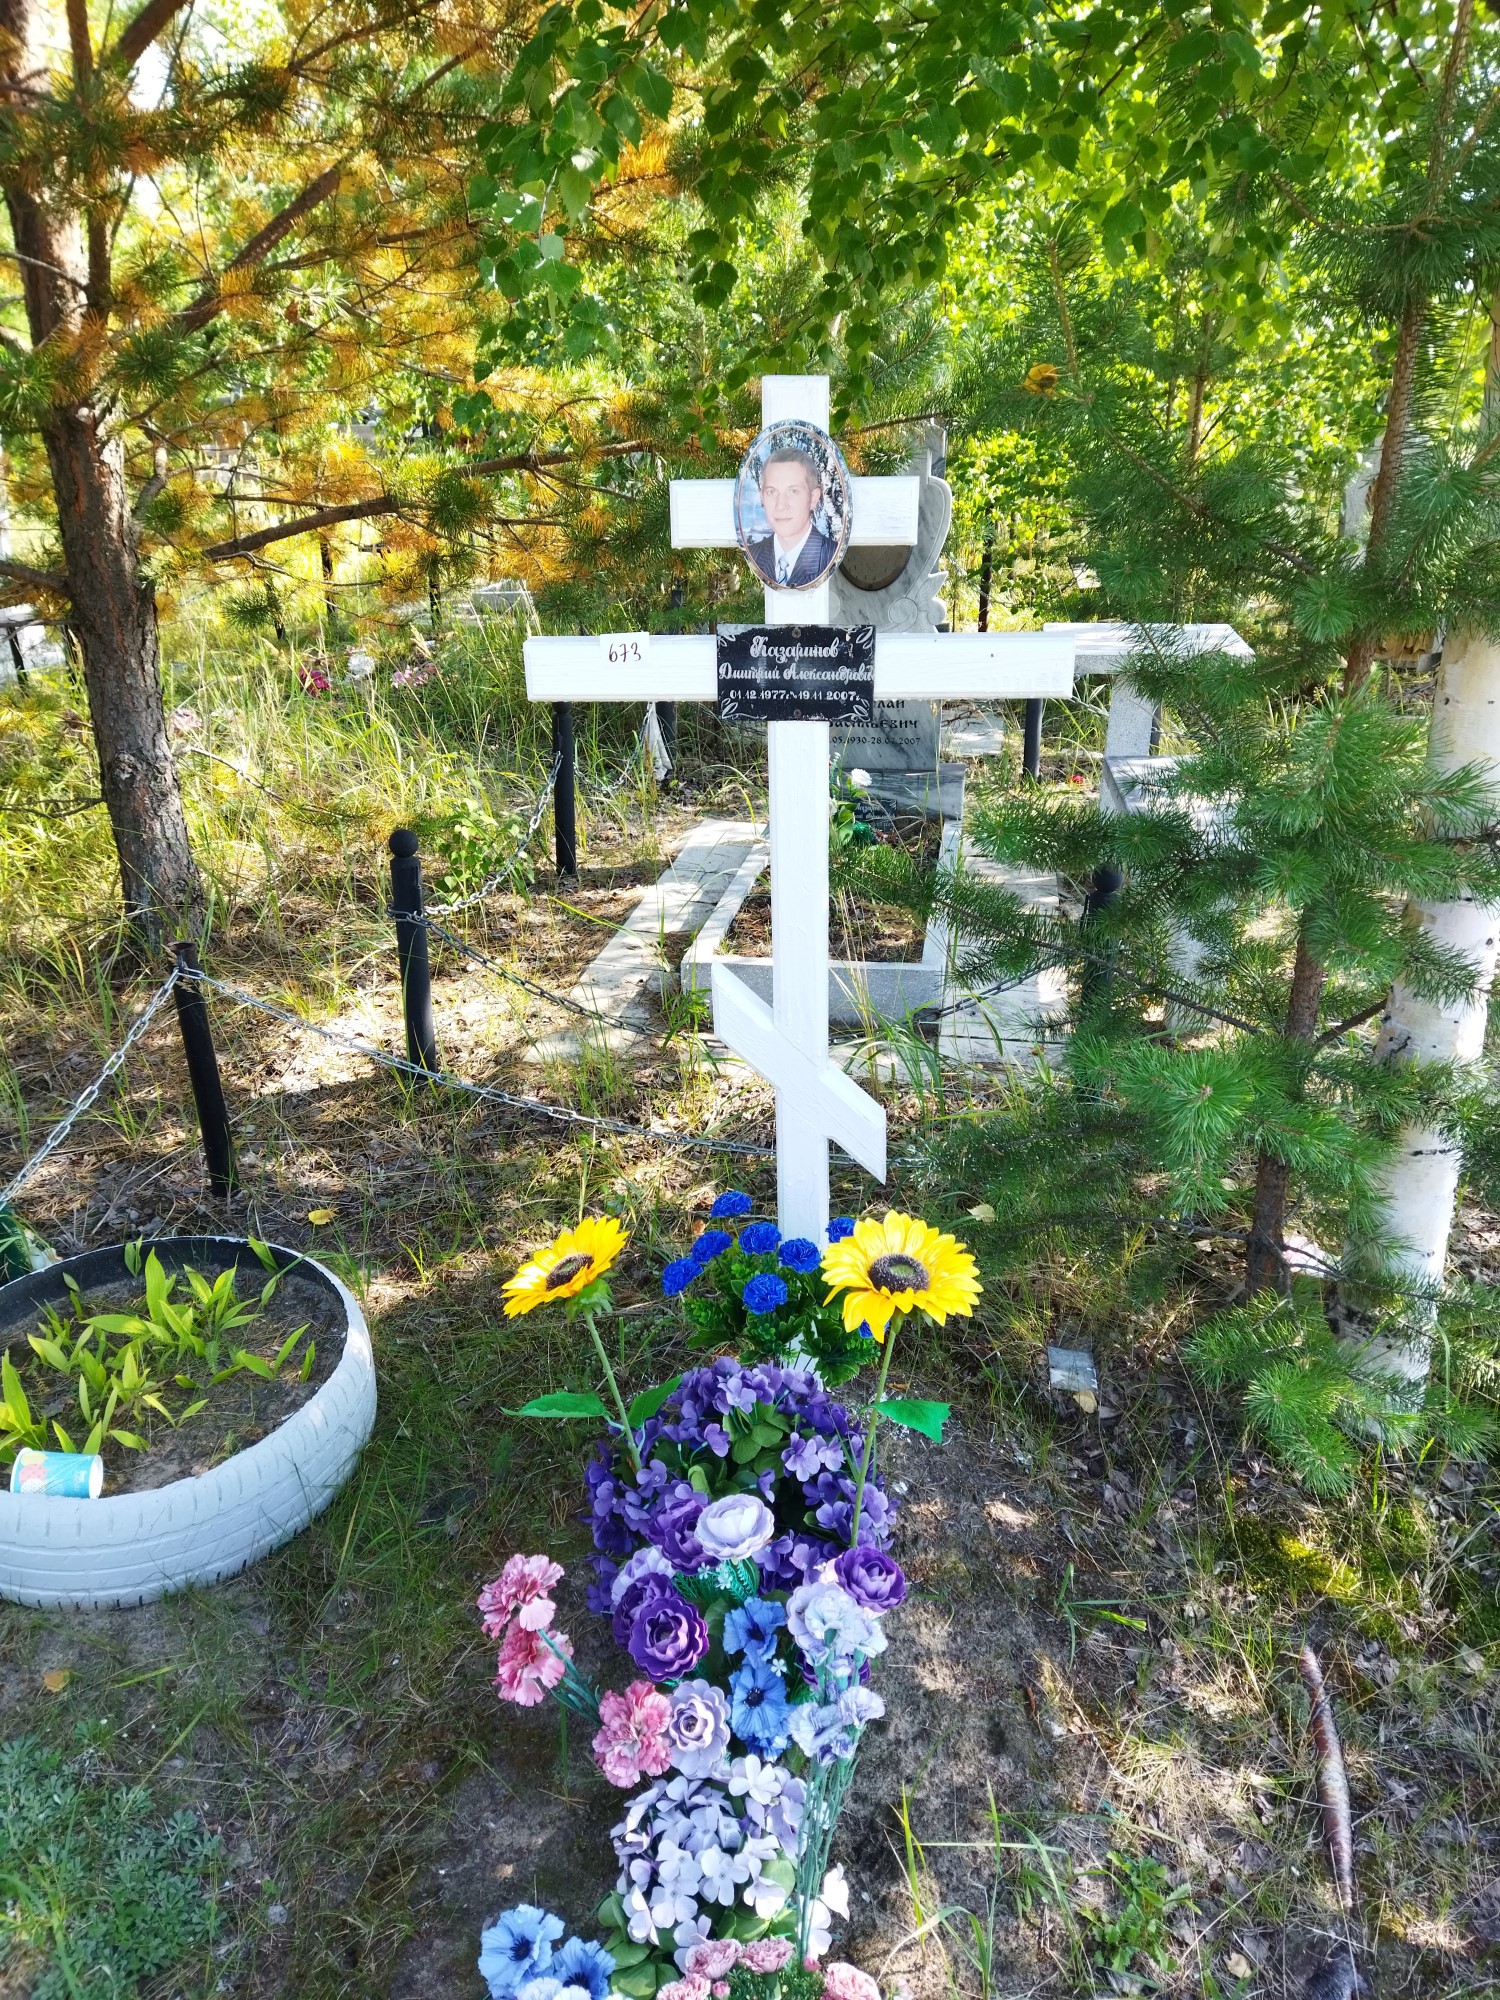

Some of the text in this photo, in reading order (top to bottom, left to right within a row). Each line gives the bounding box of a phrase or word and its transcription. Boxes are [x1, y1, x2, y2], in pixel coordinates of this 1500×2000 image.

[609, 642, 641, 662] 673
[750, 635, 840, 664] Казаринов
[719, 662, 781, 683] Дмитрий
